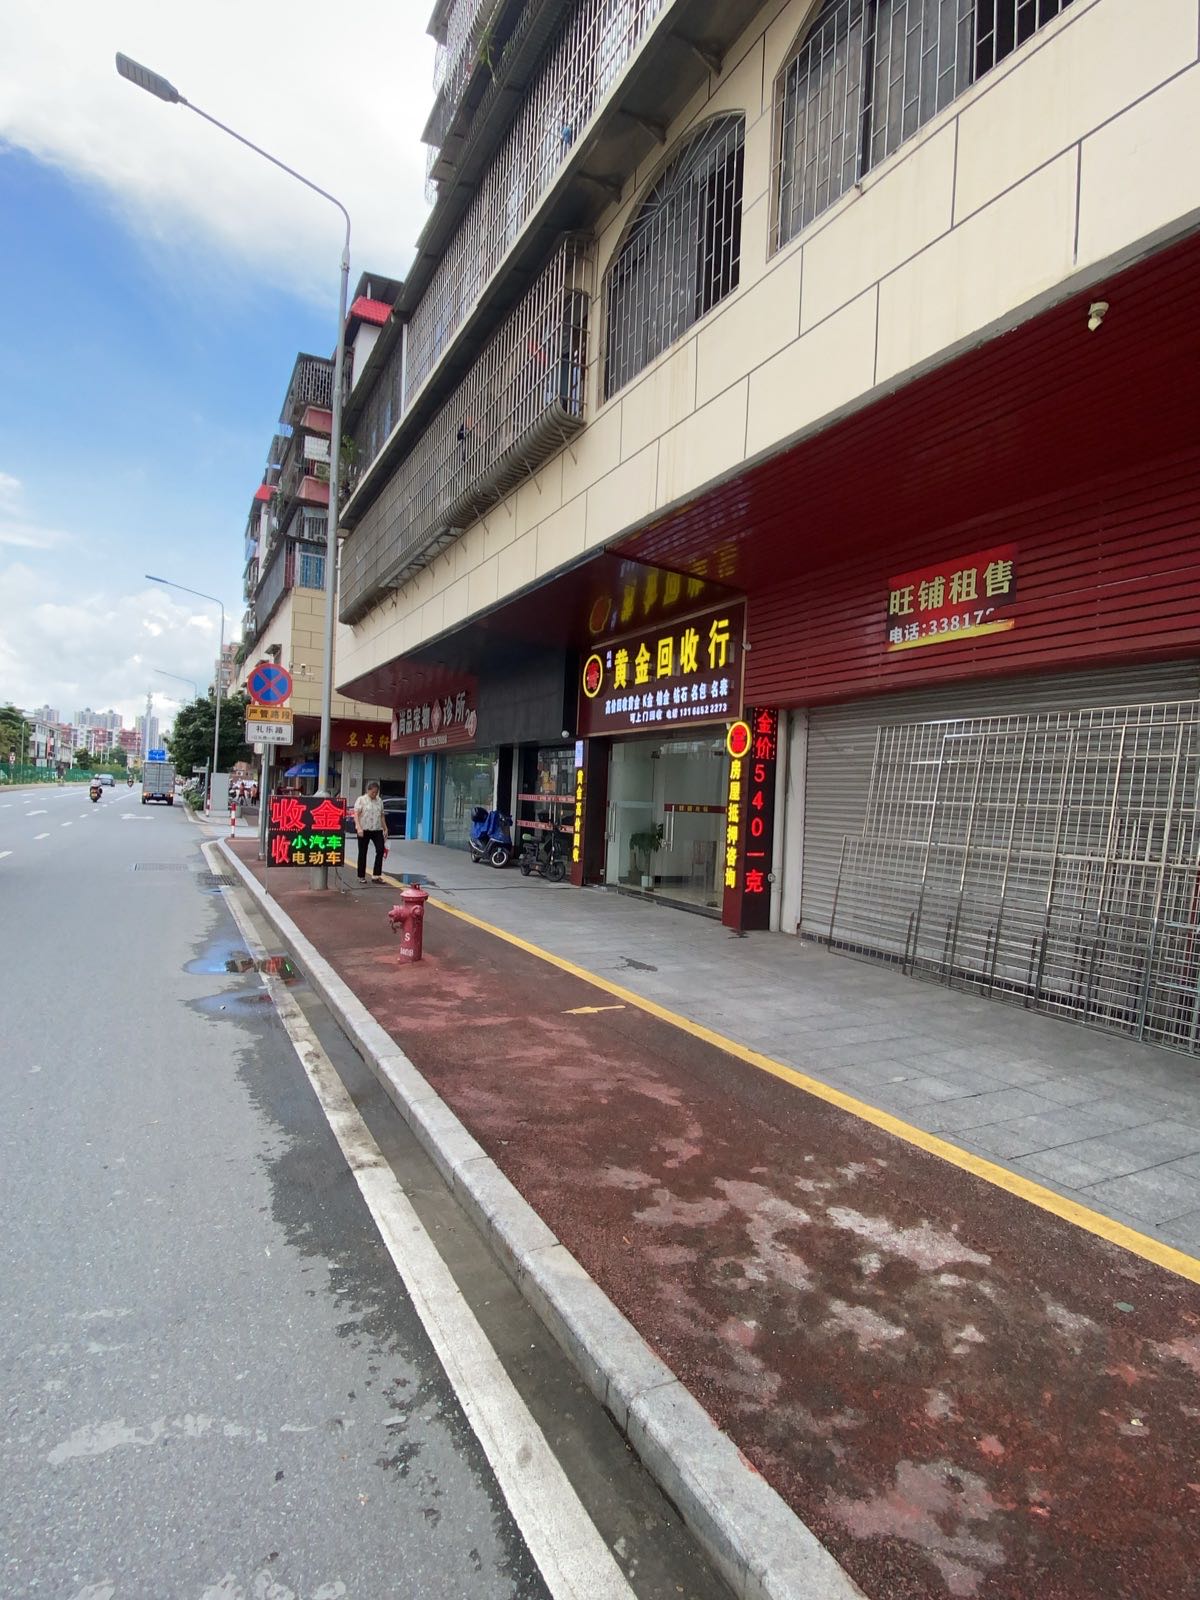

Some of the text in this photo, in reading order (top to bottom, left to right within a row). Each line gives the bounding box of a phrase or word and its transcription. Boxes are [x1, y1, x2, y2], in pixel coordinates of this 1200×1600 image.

[889, 559, 1013, 616] 旺铺租售
[889, 607, 1009, 644] 电话:33817
[613, 619, 730, 690] 黄金回收行
[443, 690, 466, 727] 诊所
[642, 692, 654, 708] K金
[673, 685, 688, 704] 钻石
[691, 682, 706, 701] 名包
[248, 708, 290, 720] 严管路段
[256, 725, 283, 734] 礼乐路
[271, 799, 344, 830] 收金
[725, 759, 742, 888] 房屋抵押咨询
[272, 833, 290, 864] 收
[292, 835, 342, 850] 小汽车
[292, 851, 342, 865] 电动车
